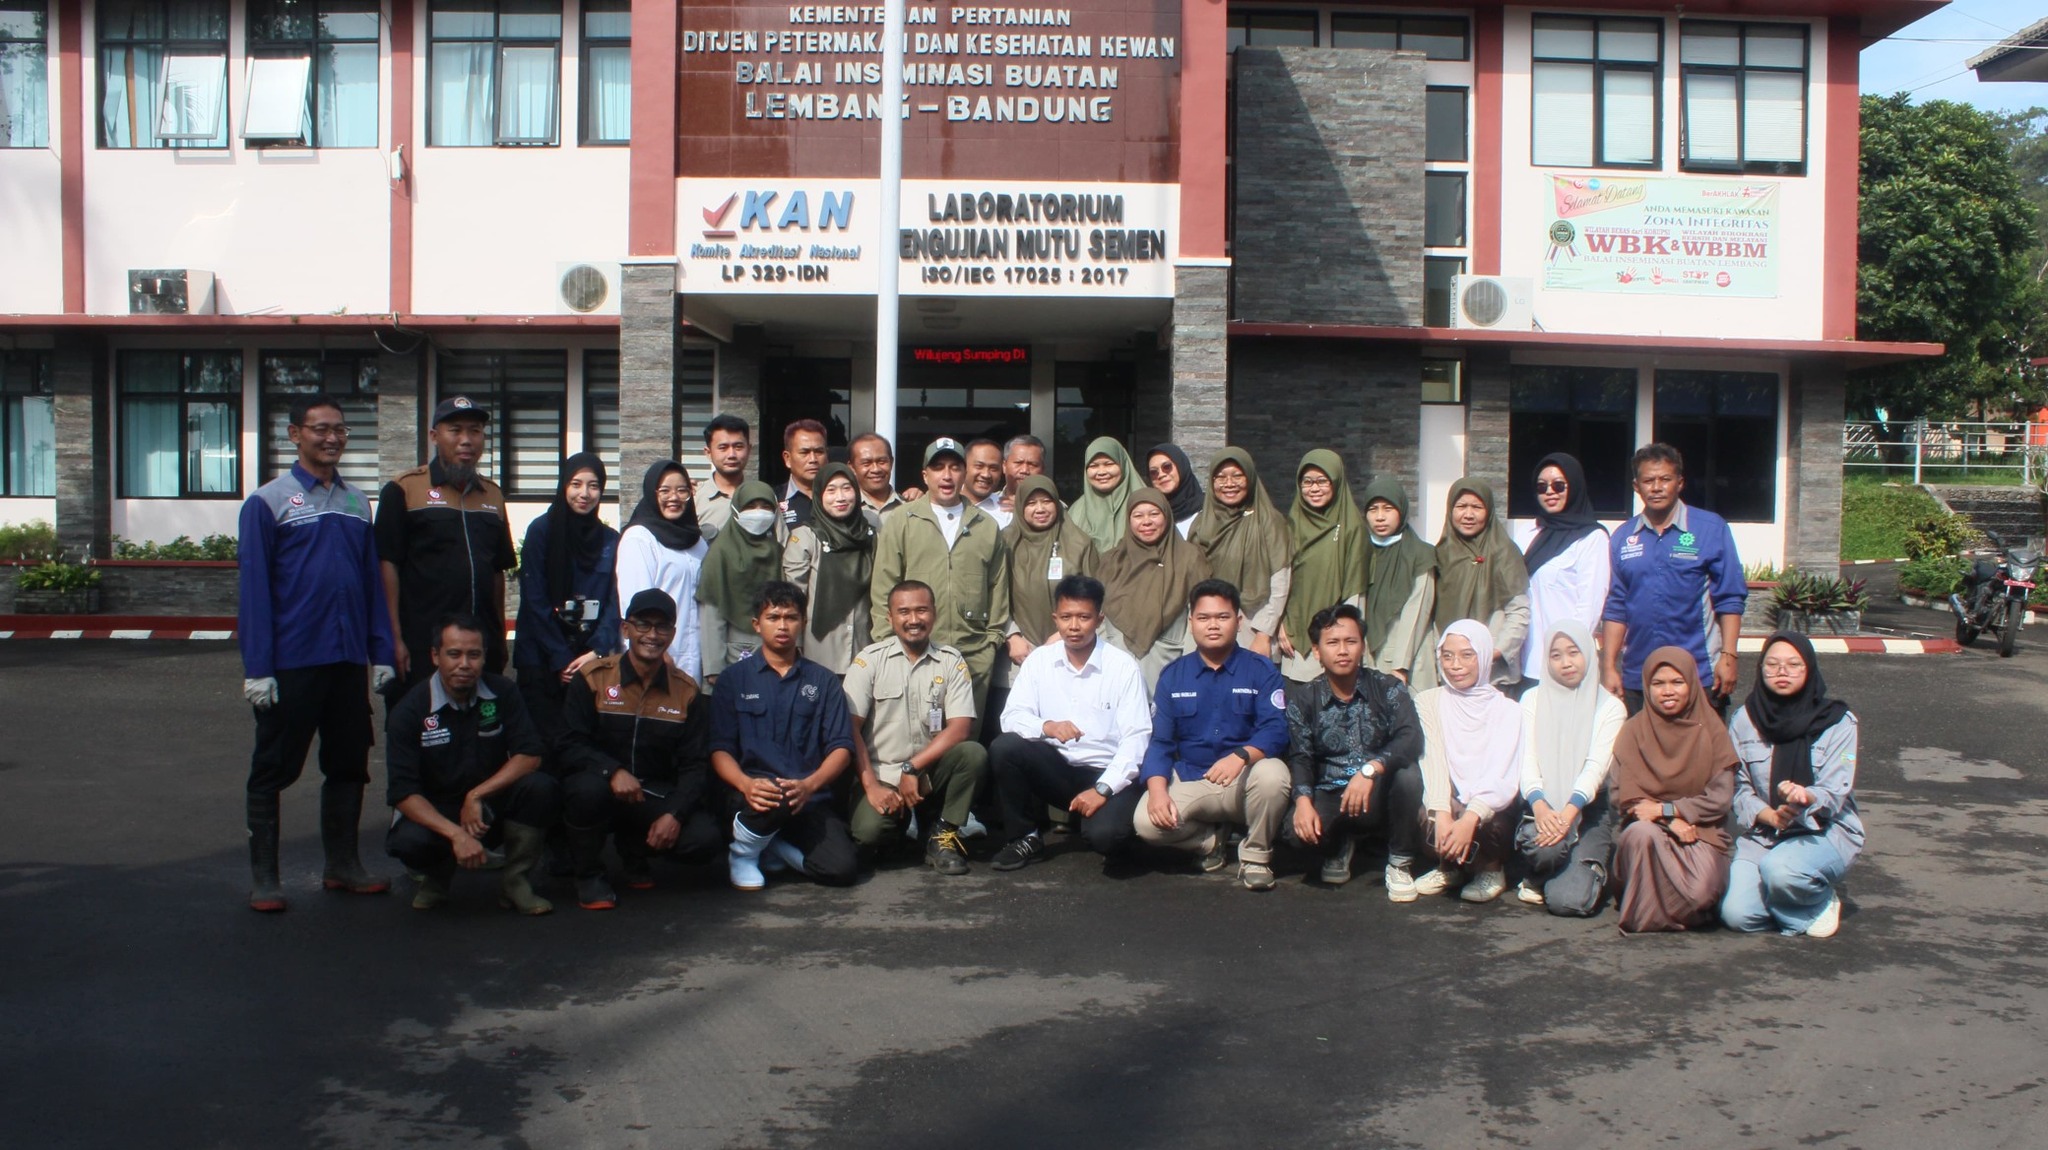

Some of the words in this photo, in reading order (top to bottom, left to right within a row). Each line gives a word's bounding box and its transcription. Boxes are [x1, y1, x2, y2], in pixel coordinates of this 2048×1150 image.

[789, 6, 936, 24] KEMENTEAN
[951, 7, 1071, 26] PERTANIAN
[683, 31, 758, 53] DITJEN
[915, 33, 959, 54] DAN
[966, 34, 1091, 57] KESEHATAN
[1101, 36, 1175, 58] KEWAN
[736, 61, 822, 85] BALAI
[835, 62, 993, 86] INSMINASI
[1005, 64, 1118, 88] BUATAN
[947, 95, 1113, 122] BANDUNG
[740, 190, 856, 231] KAN
[928, 191, 1124, 224] LABORATORIUM
[1560, 193, 1602, 215] Selamat
[1604, 184, 1644, 204] Datang
[1643, 205, 1670, 213] ANDA
[1673, 206, 1723, 215] MEMASUKI
[1725, 208, 1769, 217] KAWASAN
[1644, 215, 1683, 226] ZONA
[1688, 217, 1769, 229] INTEGRITAS
[690, 243, 731, 260] Komite
[739, 244, 802, 260] Akreditasi
[809, 244, 862, 261] Nasional
[899, 228, 1008, 261] ENGUJIAN
[1016, 229, 1081, 260] MUTU
[1088, 229, 1165, 260] SEMEN
[1584, 234, 1671, 255] WBK
[1671, 240, 1680, 251] &
[1682, 241, 1767, 258] WBBM
[722, 264, 745, 281] LP
[752, 264, 829, 282] 329-IDN
[1614, 257, 1674, 266] INSEMINASI
[1719, 260, 1767, 268] LEMBANG
[921, 266, 996, 285] ISO/IEC
[1004, 267, 1062, 285] 17025
[1081, 267, 1129, 286] 2017
[963, 348, 1011, 363] Sumping
